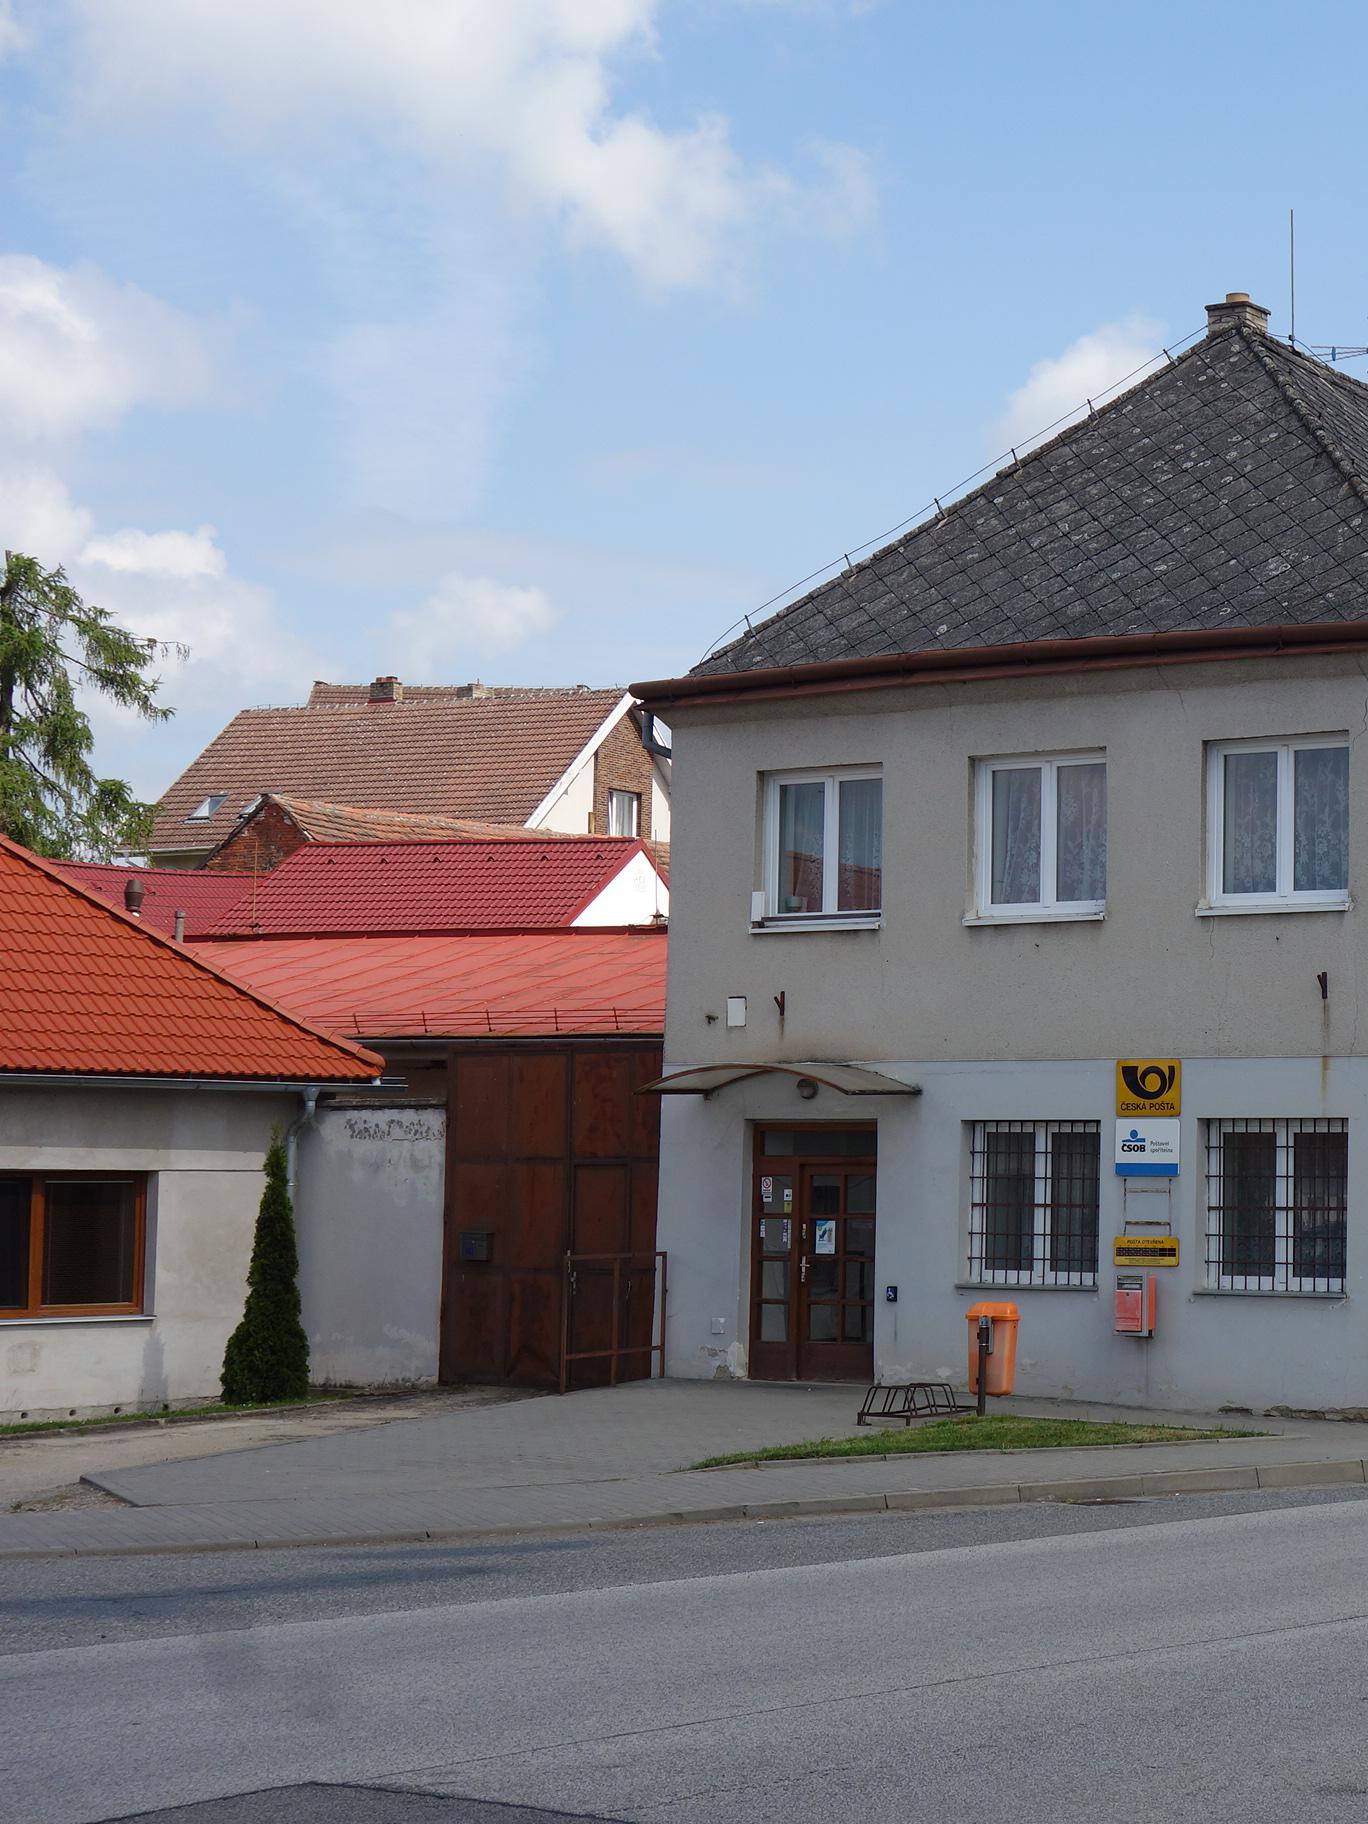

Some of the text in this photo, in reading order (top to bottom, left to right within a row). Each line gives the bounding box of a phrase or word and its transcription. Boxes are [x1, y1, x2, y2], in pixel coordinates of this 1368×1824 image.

[1120, 1101, 1175, 1111] ČESKÁ POŠTA
[1121, 1143, 1146, 1153] ČSOB
